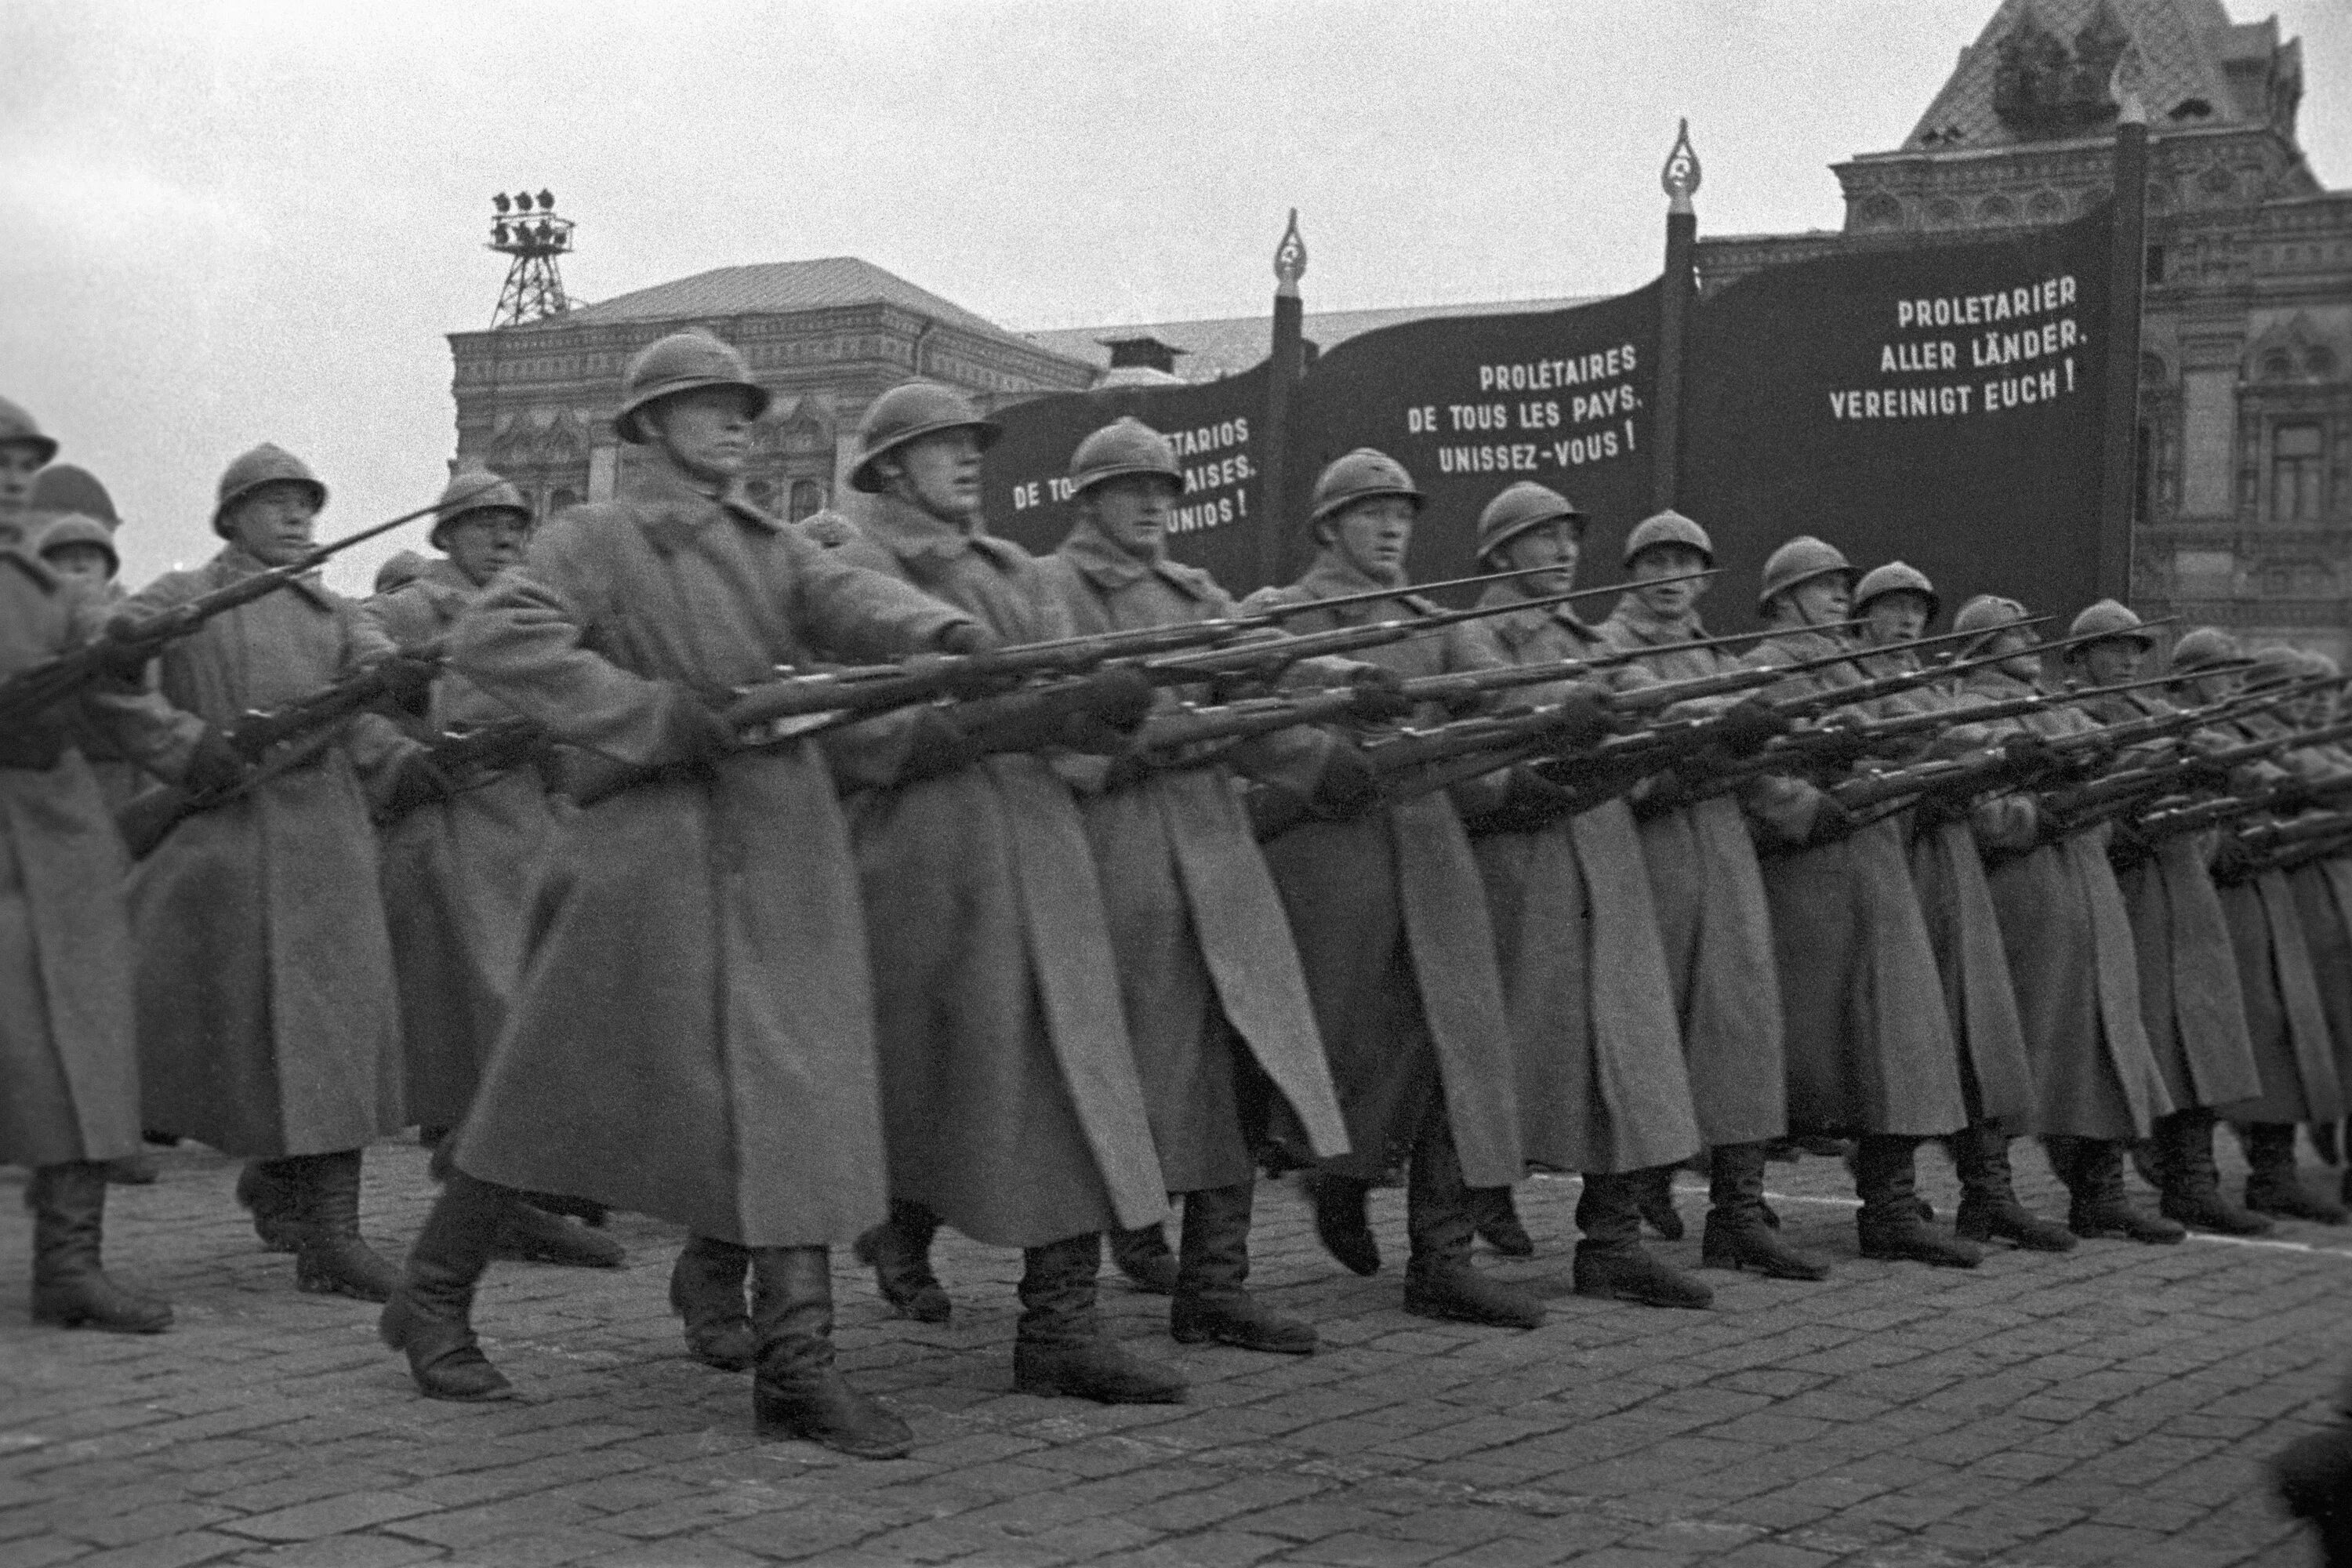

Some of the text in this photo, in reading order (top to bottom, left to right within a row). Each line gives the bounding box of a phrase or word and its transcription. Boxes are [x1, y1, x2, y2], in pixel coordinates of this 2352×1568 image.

[1897, 275, 2077, 328] PROLETARIER
[1479, 343, 1637, 391] PROLÉTAIRES
[1880, 318, 2087, 372] ALLER LÄNDER.
[1407, 405, 1438, 434] DE
[1448, 403, 1508, 431] TOUS
[1519, 401, 1561, 430] LES
[1829, 385, 1973, 419] VEREINIGT
[1012, 481, 1040, 511] DE
[1184, 454, 1257, 495] AISES.
